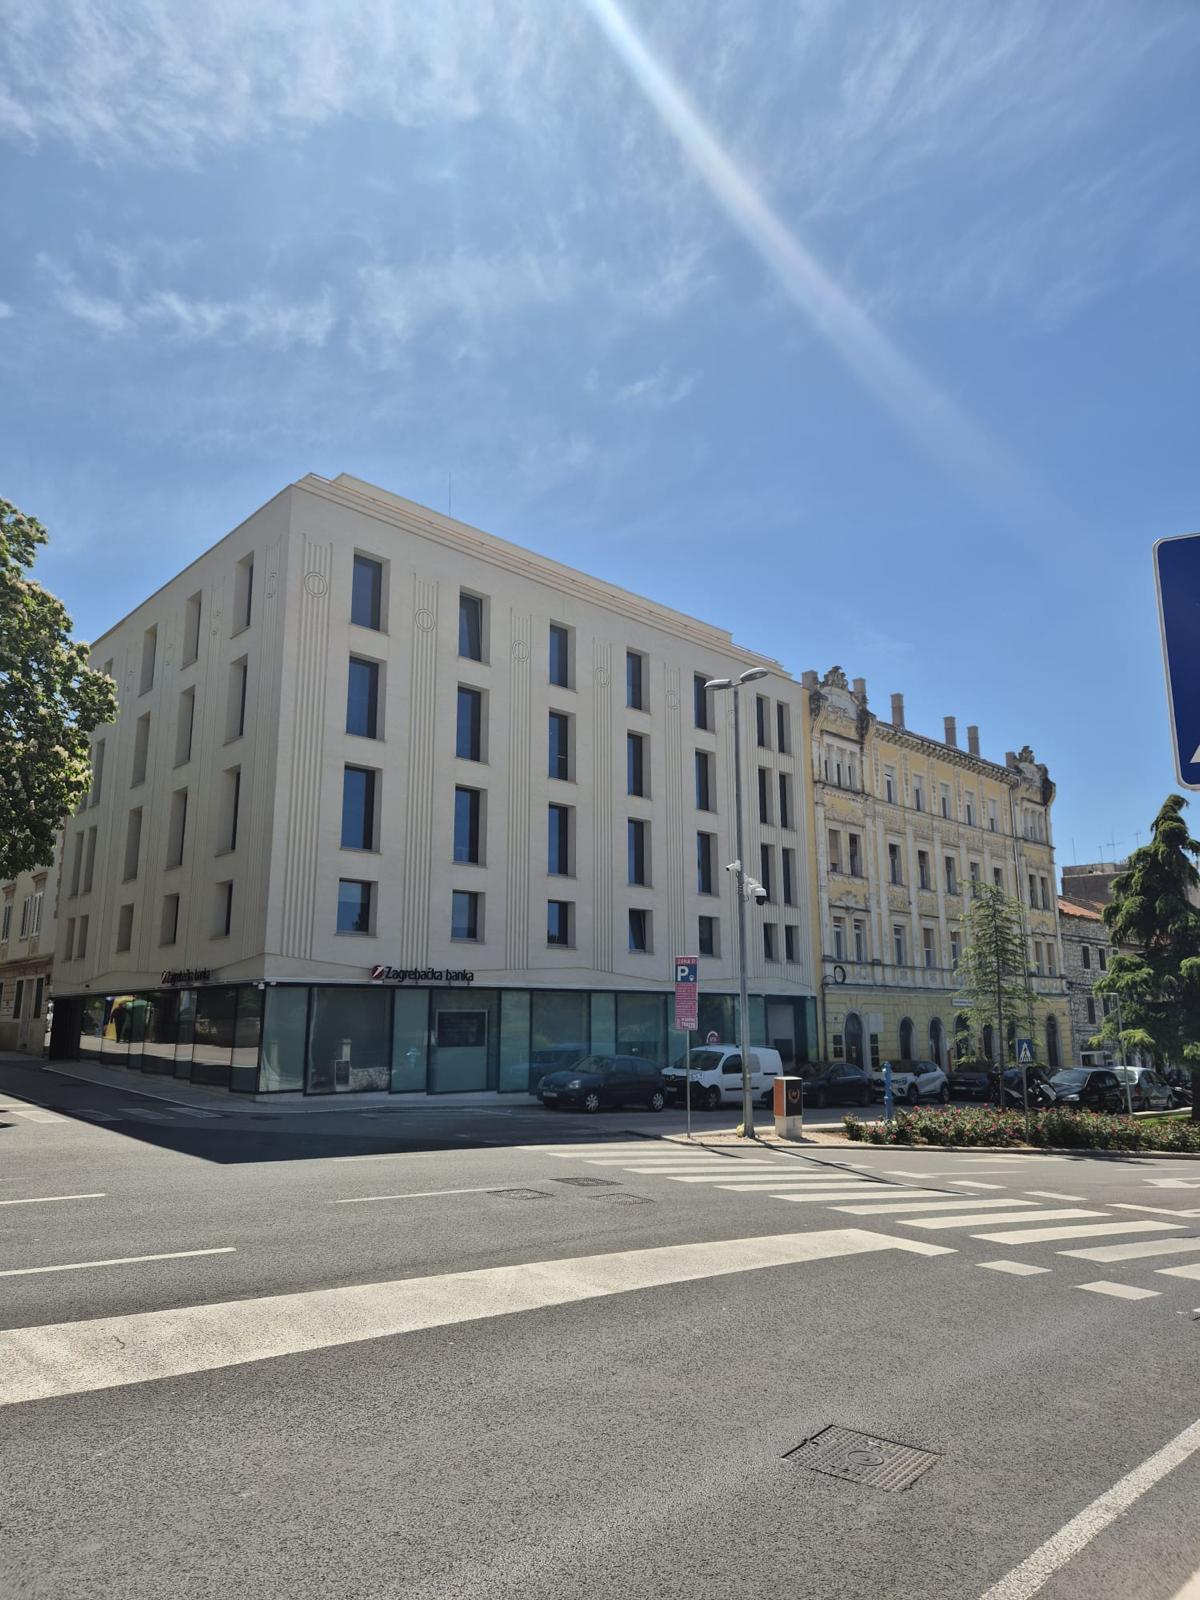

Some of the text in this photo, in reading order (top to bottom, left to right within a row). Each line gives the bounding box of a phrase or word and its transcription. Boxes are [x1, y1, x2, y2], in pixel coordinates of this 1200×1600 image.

[385, 966, 474, 983] Zagrebačka banka
[677, 966, 689, 982] P
